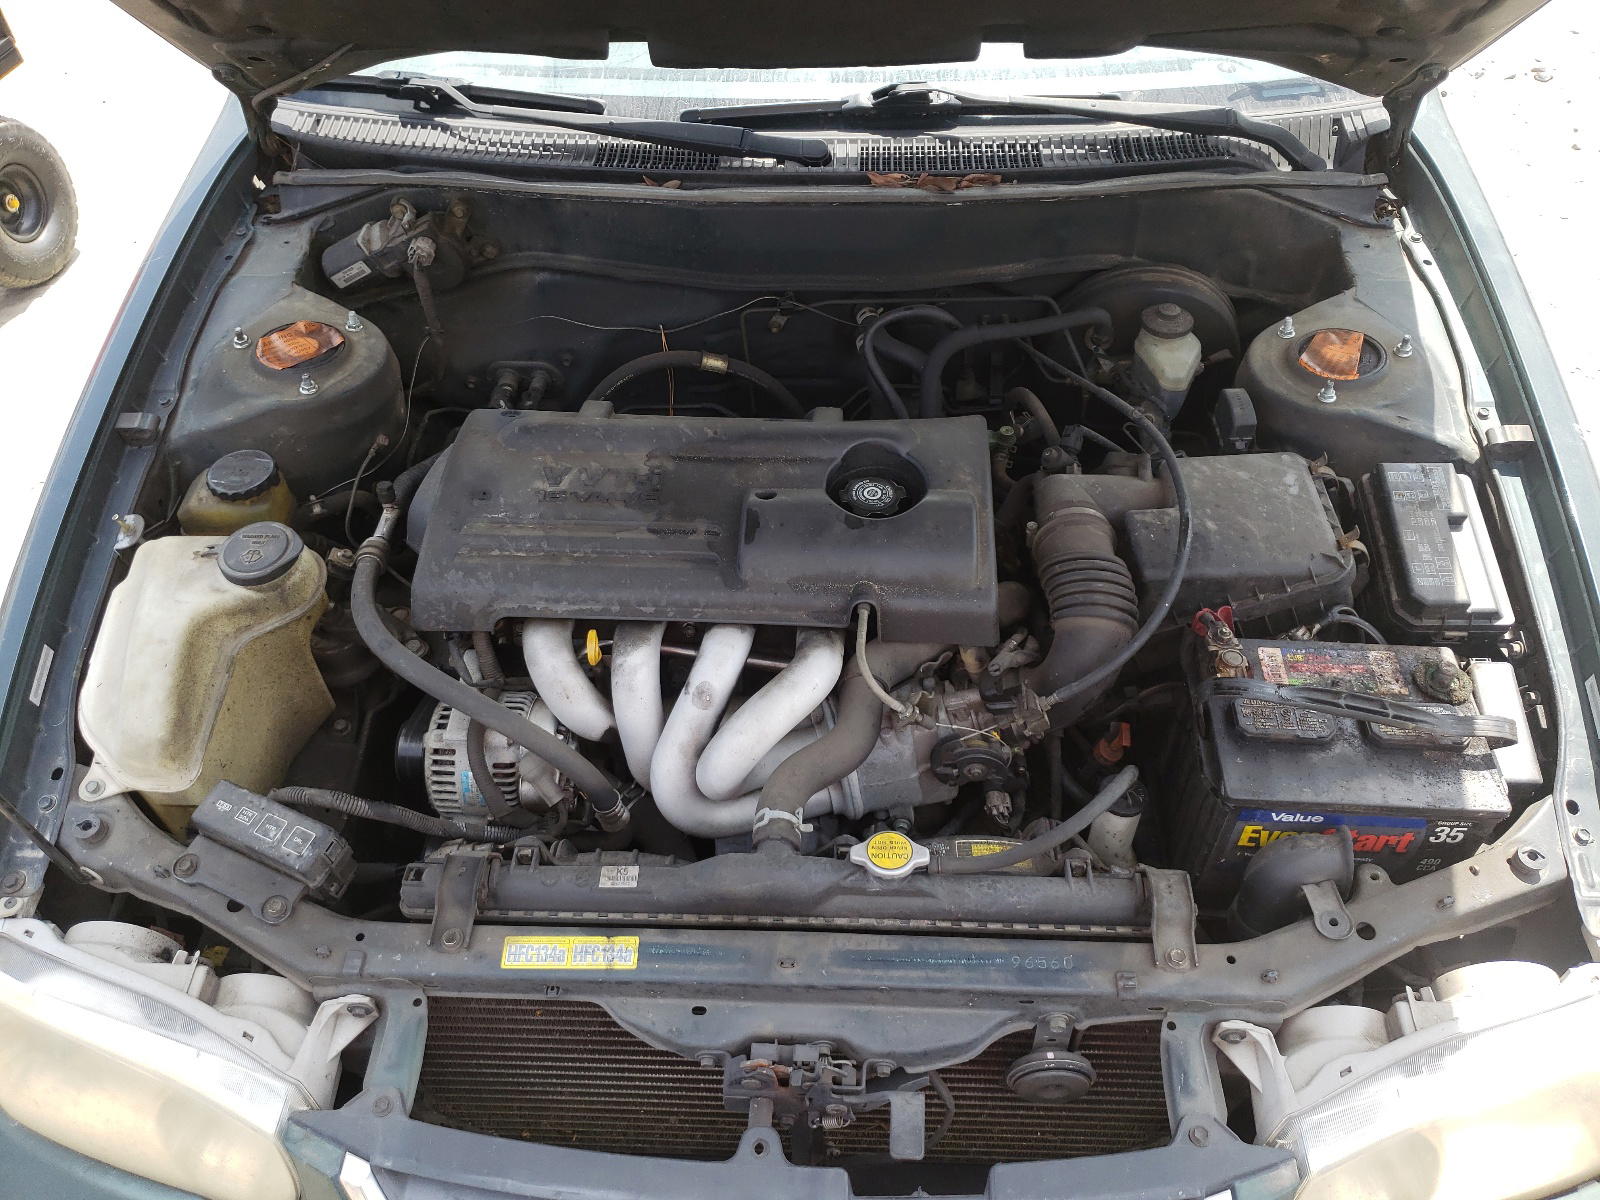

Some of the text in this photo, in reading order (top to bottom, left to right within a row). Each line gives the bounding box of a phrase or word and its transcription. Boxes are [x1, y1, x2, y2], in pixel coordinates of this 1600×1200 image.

[1271, 812, 1324, 823] Value
[1429, 826, 1468, 843] 35
[871, 852, 909, 860] CAUTION
[506, 943, 566, 963] HFC134a
